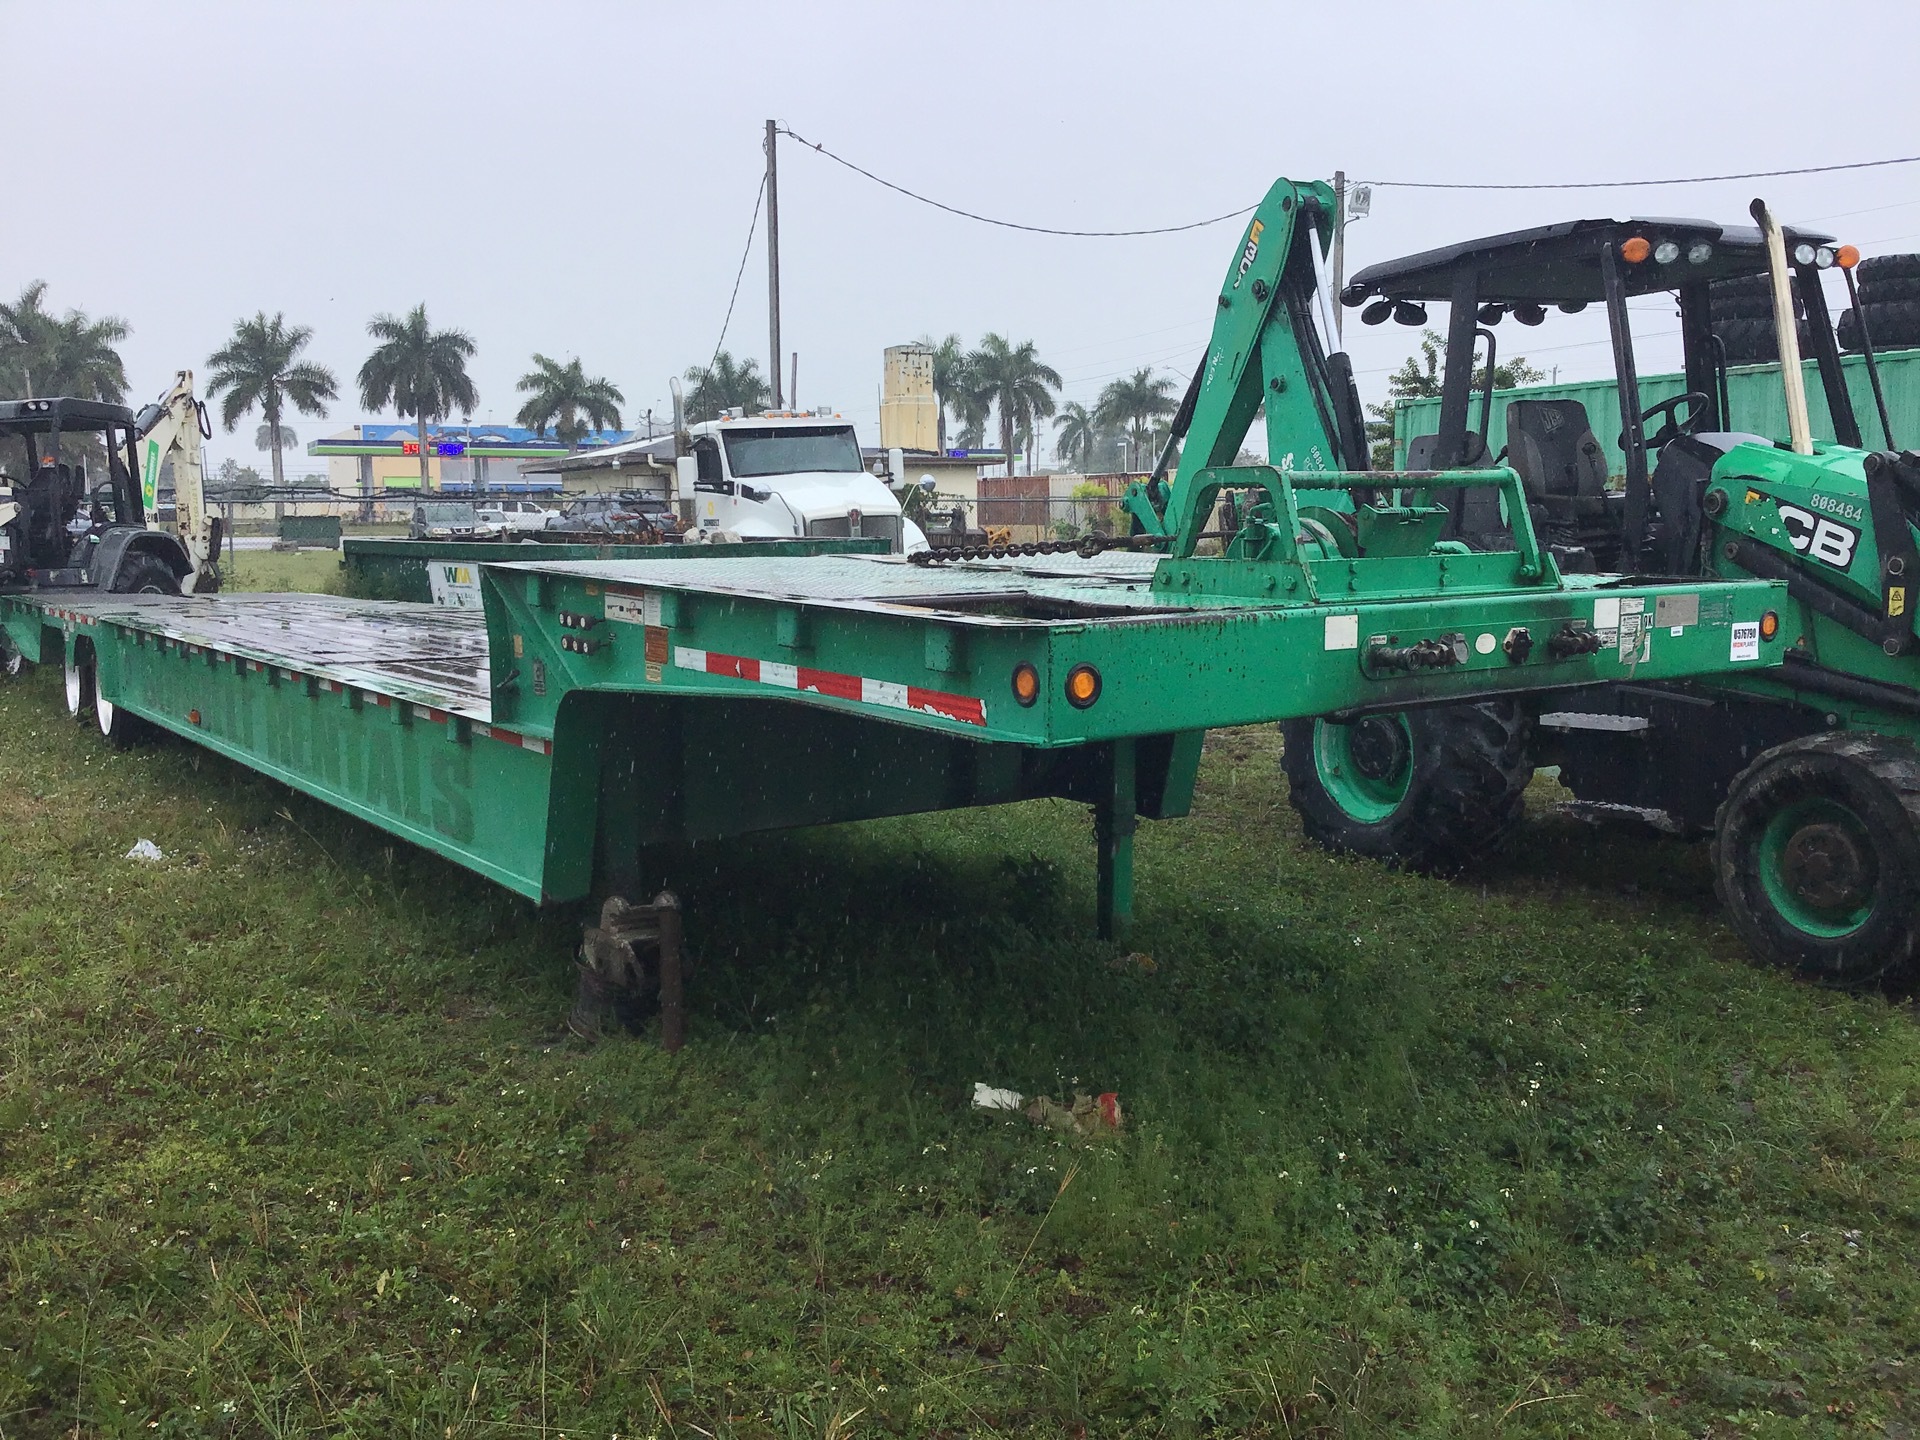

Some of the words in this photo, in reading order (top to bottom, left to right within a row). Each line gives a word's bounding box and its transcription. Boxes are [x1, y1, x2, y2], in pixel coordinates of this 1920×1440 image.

[1811, 493, 1863, 521] 808484
[1776, 505, 1856, 567] CB
[443, 567, 471, 583] WM
